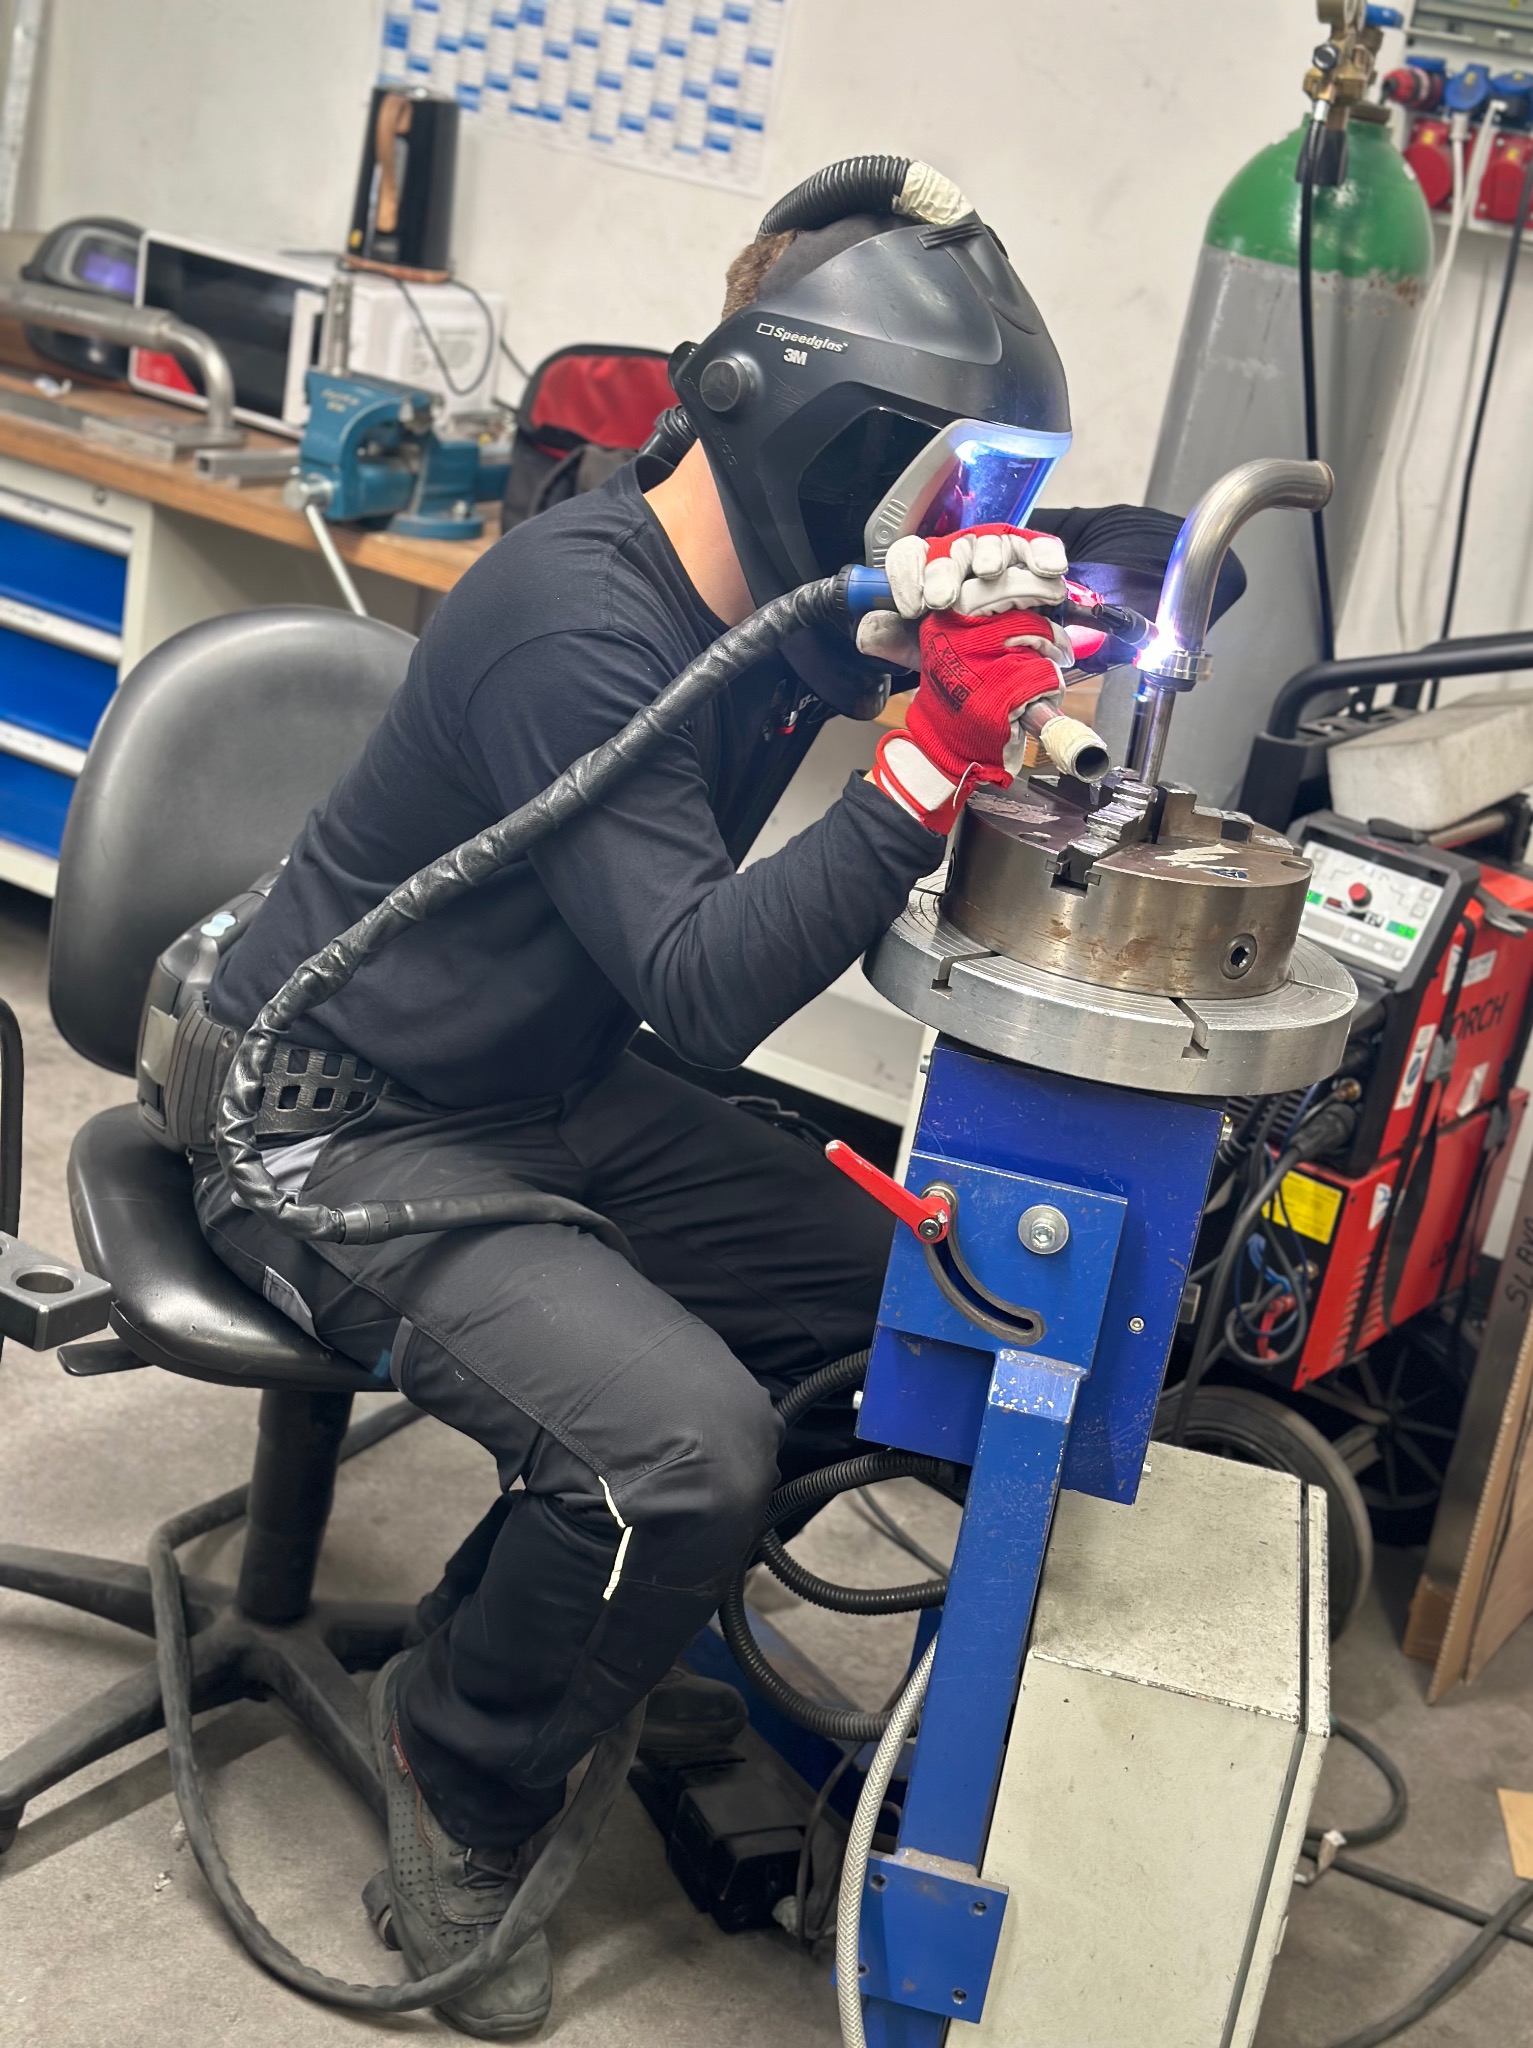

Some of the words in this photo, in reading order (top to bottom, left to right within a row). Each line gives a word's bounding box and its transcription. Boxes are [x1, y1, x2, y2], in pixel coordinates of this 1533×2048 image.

[773, 327, 844, 352] Speedglas
[783, 348, 808, 366] 3M
[953, 686, 968, 701] 10
[1453, 991, 1509, 1040] ORCH
